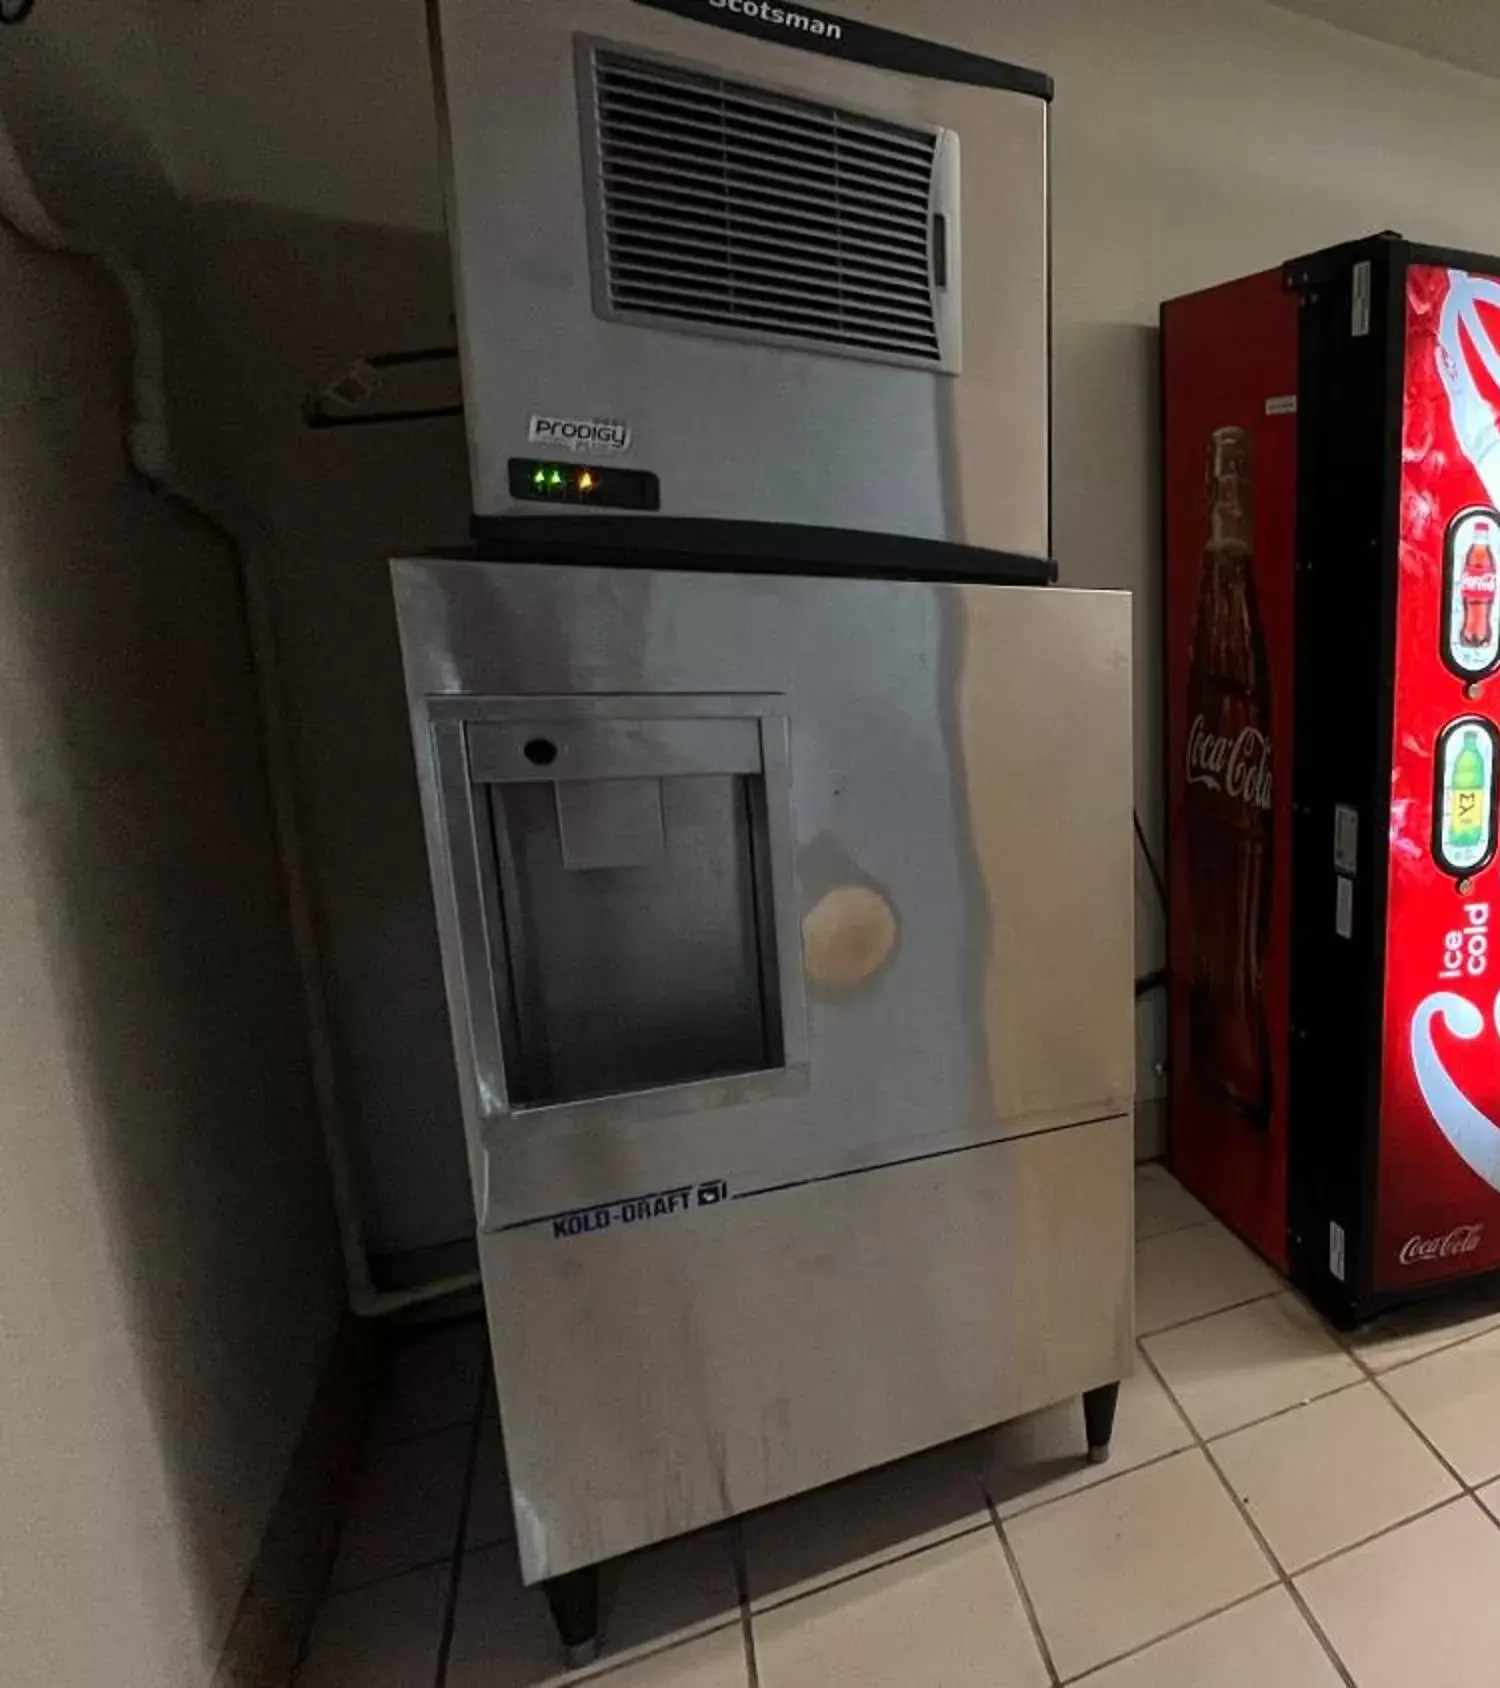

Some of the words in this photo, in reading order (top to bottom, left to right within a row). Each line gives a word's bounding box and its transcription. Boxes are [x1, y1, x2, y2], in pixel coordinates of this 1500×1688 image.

[1186, 713, 1273, 810] Coca-Cola
[1463, 902, 1489, 976] cold
[553, 1192, 691, 1239] KOLD-DRAFT
[1400, 1222, 1485, 1265] Coca-Cola
